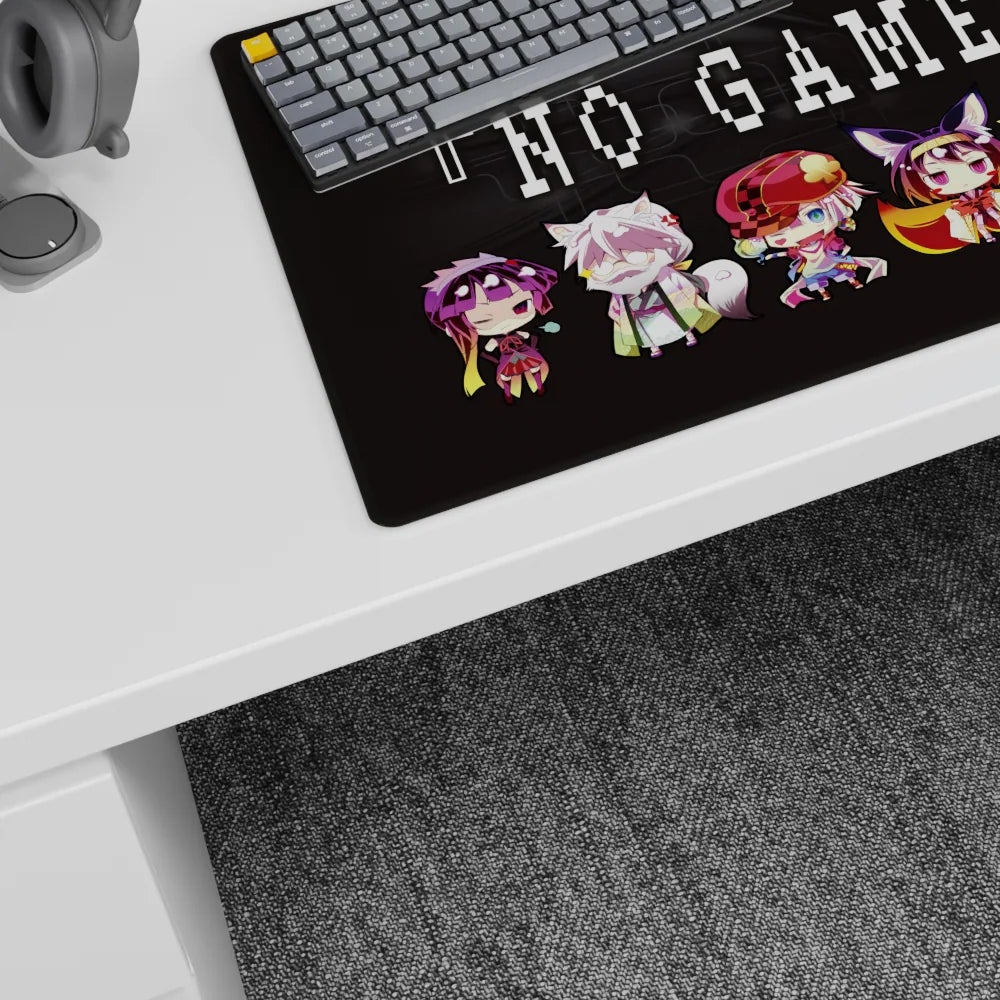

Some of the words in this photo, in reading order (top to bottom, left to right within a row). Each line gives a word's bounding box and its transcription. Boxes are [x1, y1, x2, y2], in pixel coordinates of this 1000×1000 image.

[390, 114, 417, 128] command
[355, 132, 374, 142] option
[314, 148, 334, 158] control
